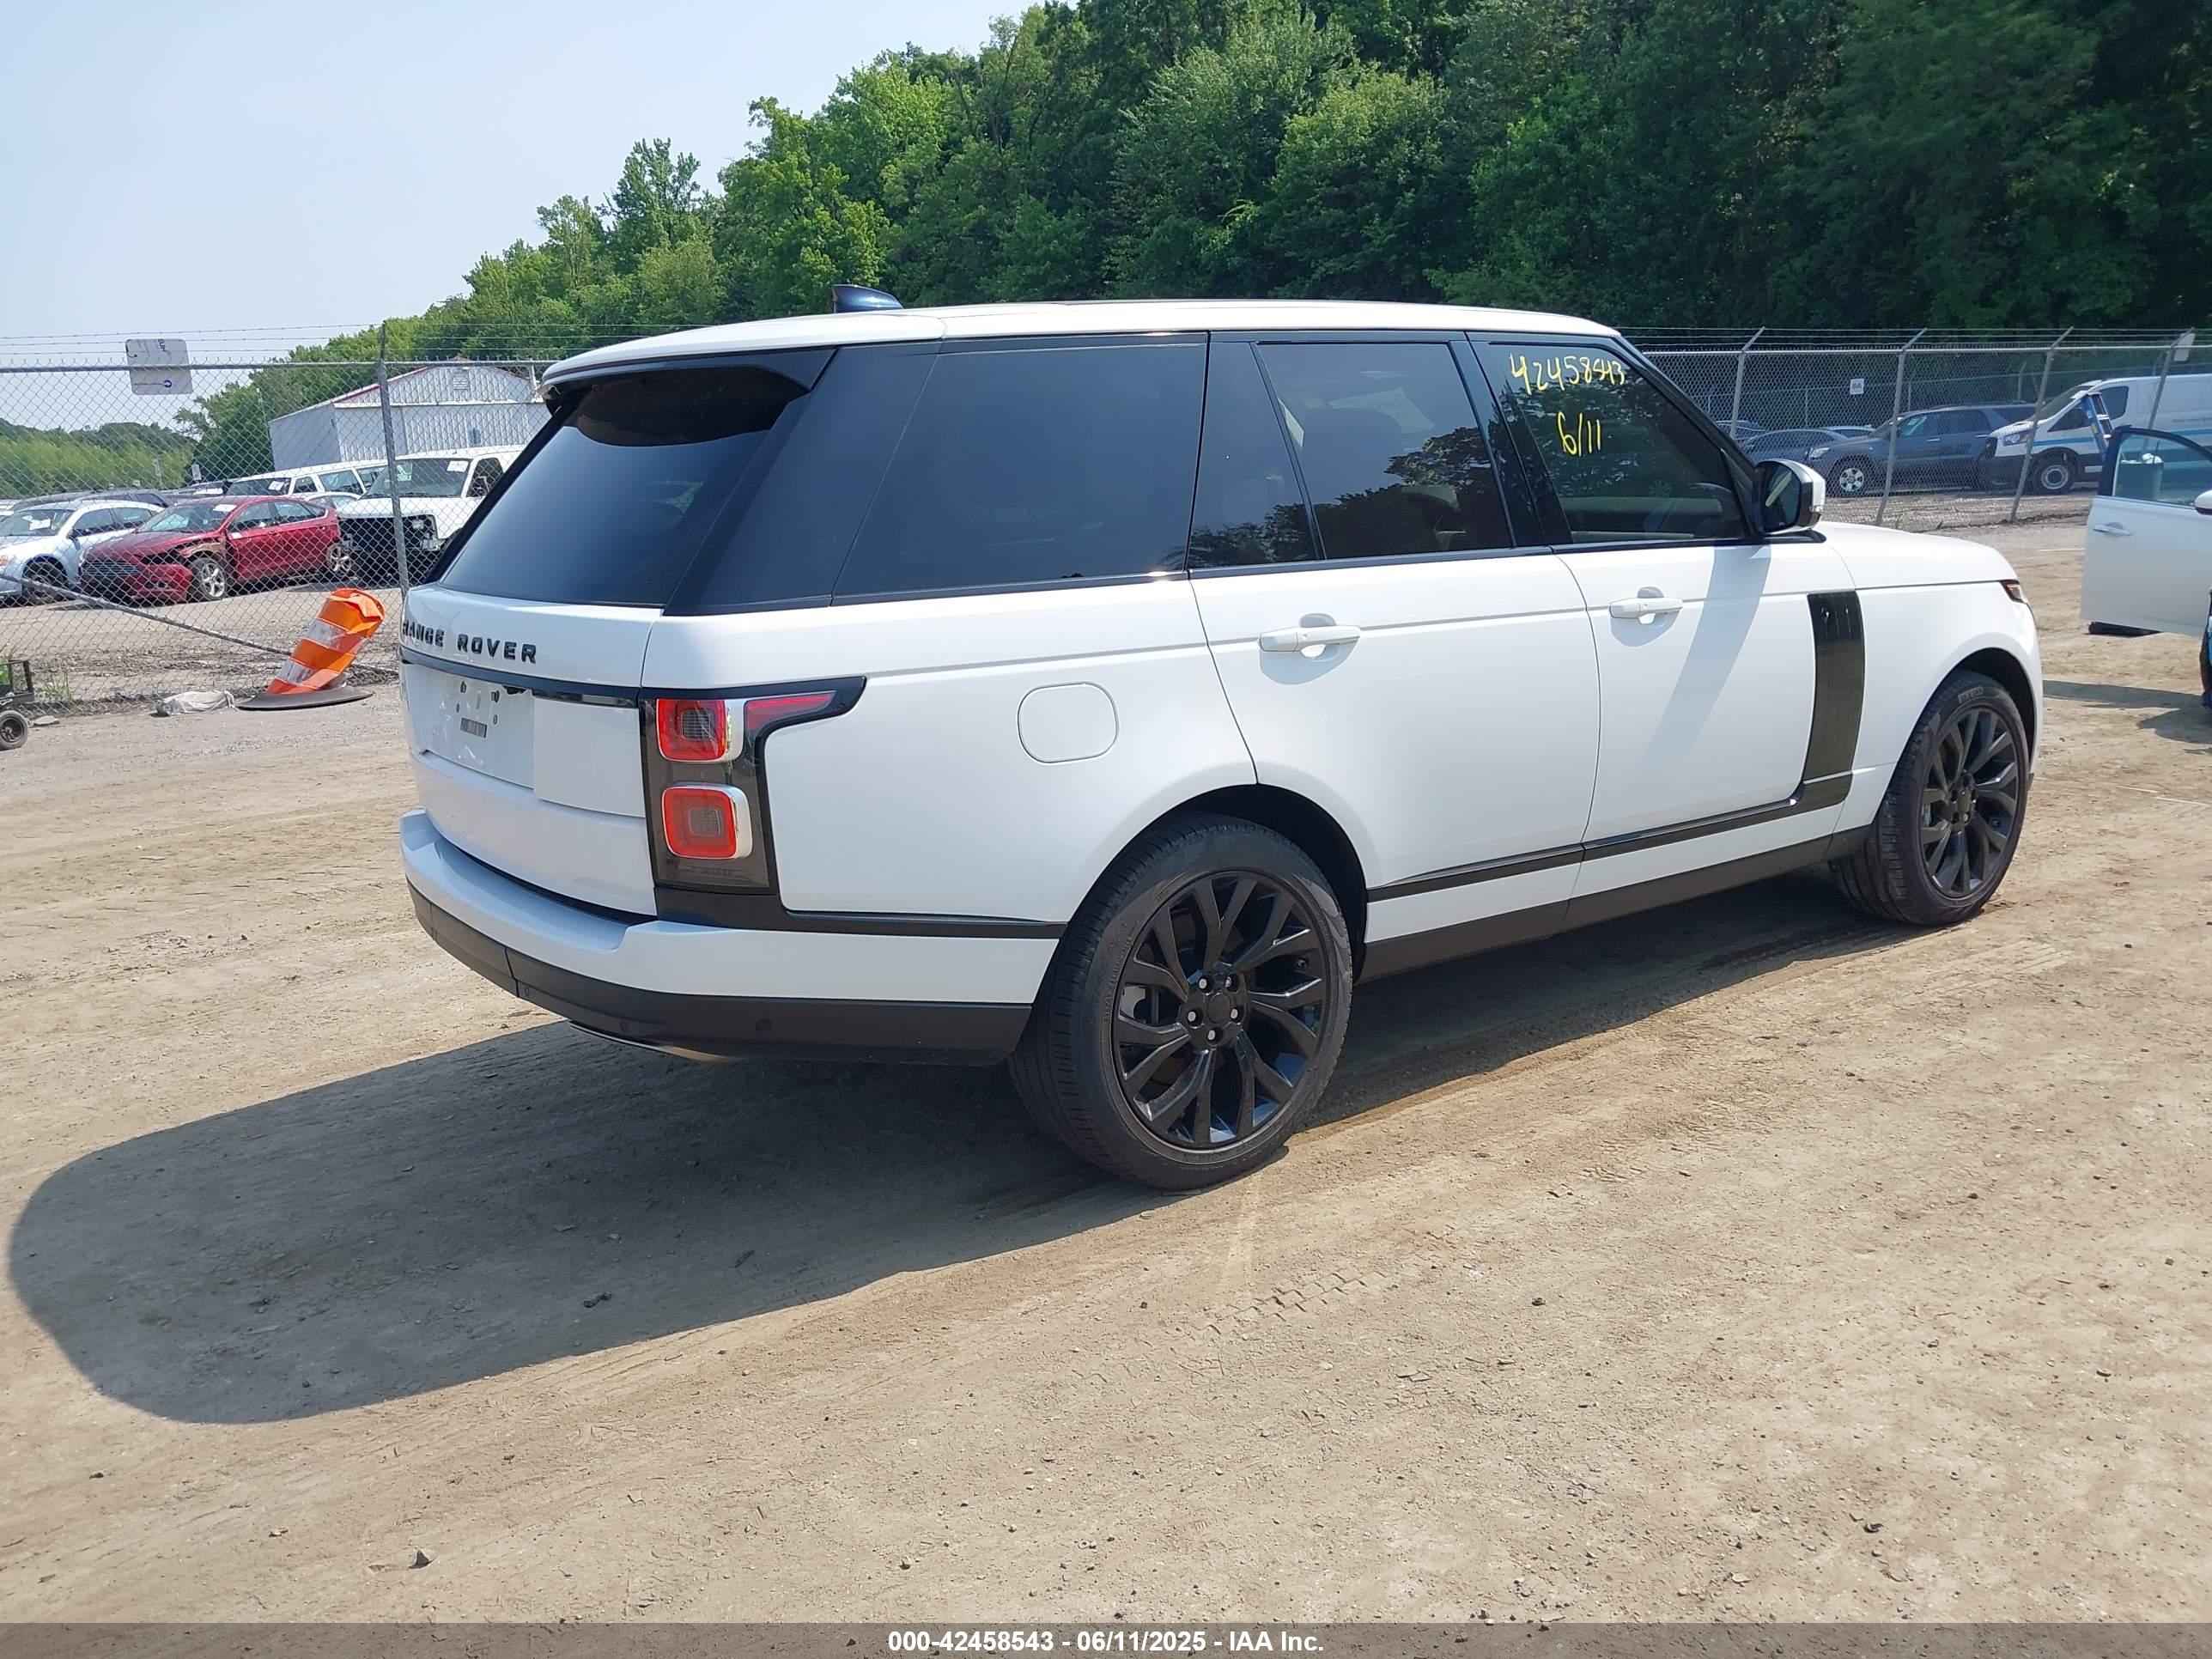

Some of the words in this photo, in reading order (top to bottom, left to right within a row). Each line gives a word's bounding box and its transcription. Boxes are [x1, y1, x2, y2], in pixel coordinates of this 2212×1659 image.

[1509, 353, 1626, 395] 42458543
[1557, 411, 1601, 458] 6/11
[402, 619, 445, 647] RANGE
[457, 633, 537, 664] ROVER
